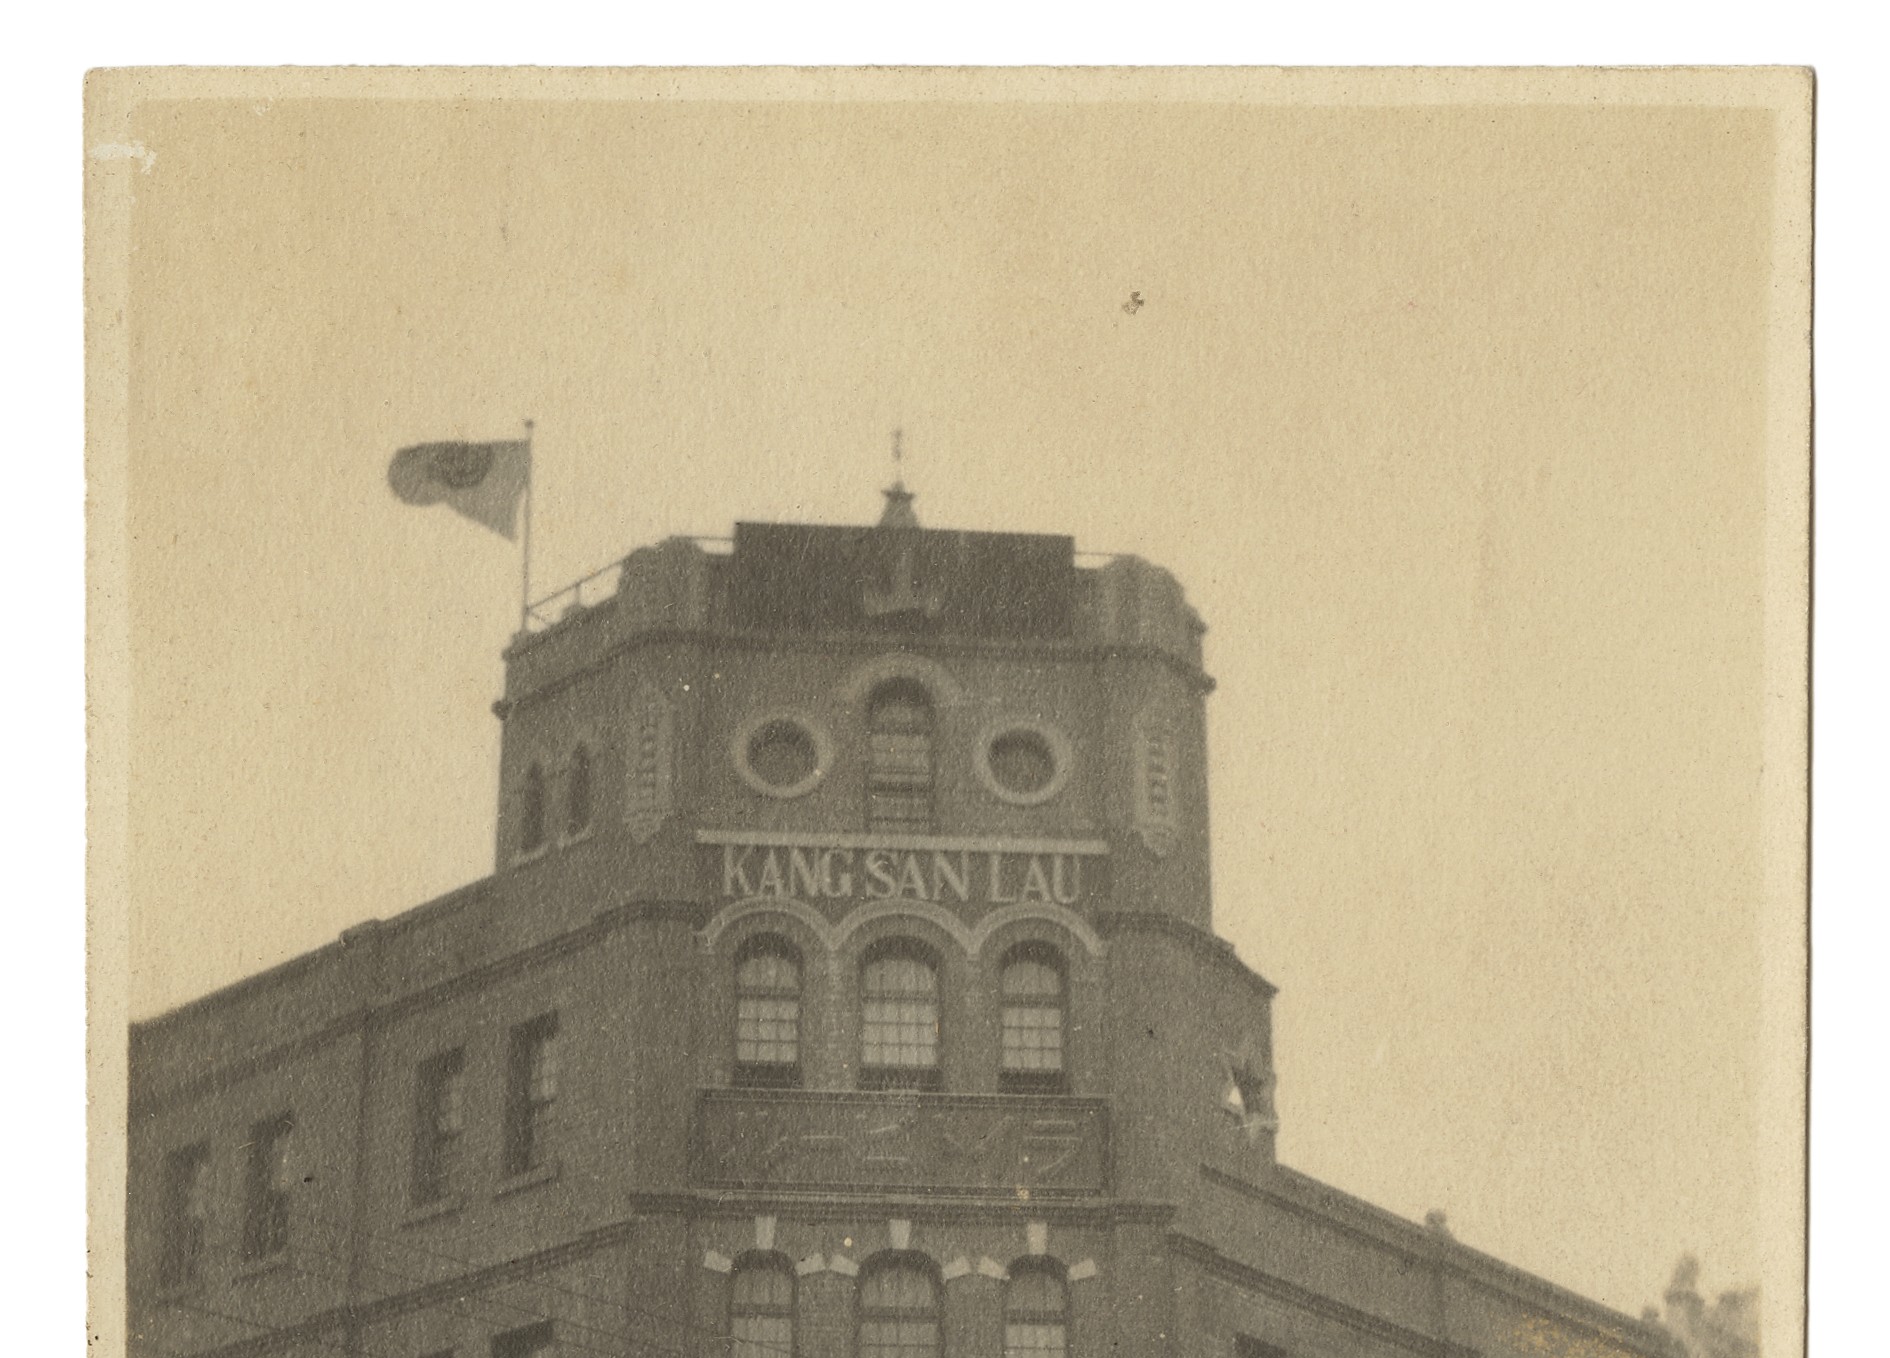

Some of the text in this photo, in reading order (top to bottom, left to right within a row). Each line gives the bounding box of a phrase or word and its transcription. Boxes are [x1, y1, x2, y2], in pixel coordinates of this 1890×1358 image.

[723, 845, 1081, 904] KANG SAN LAU
